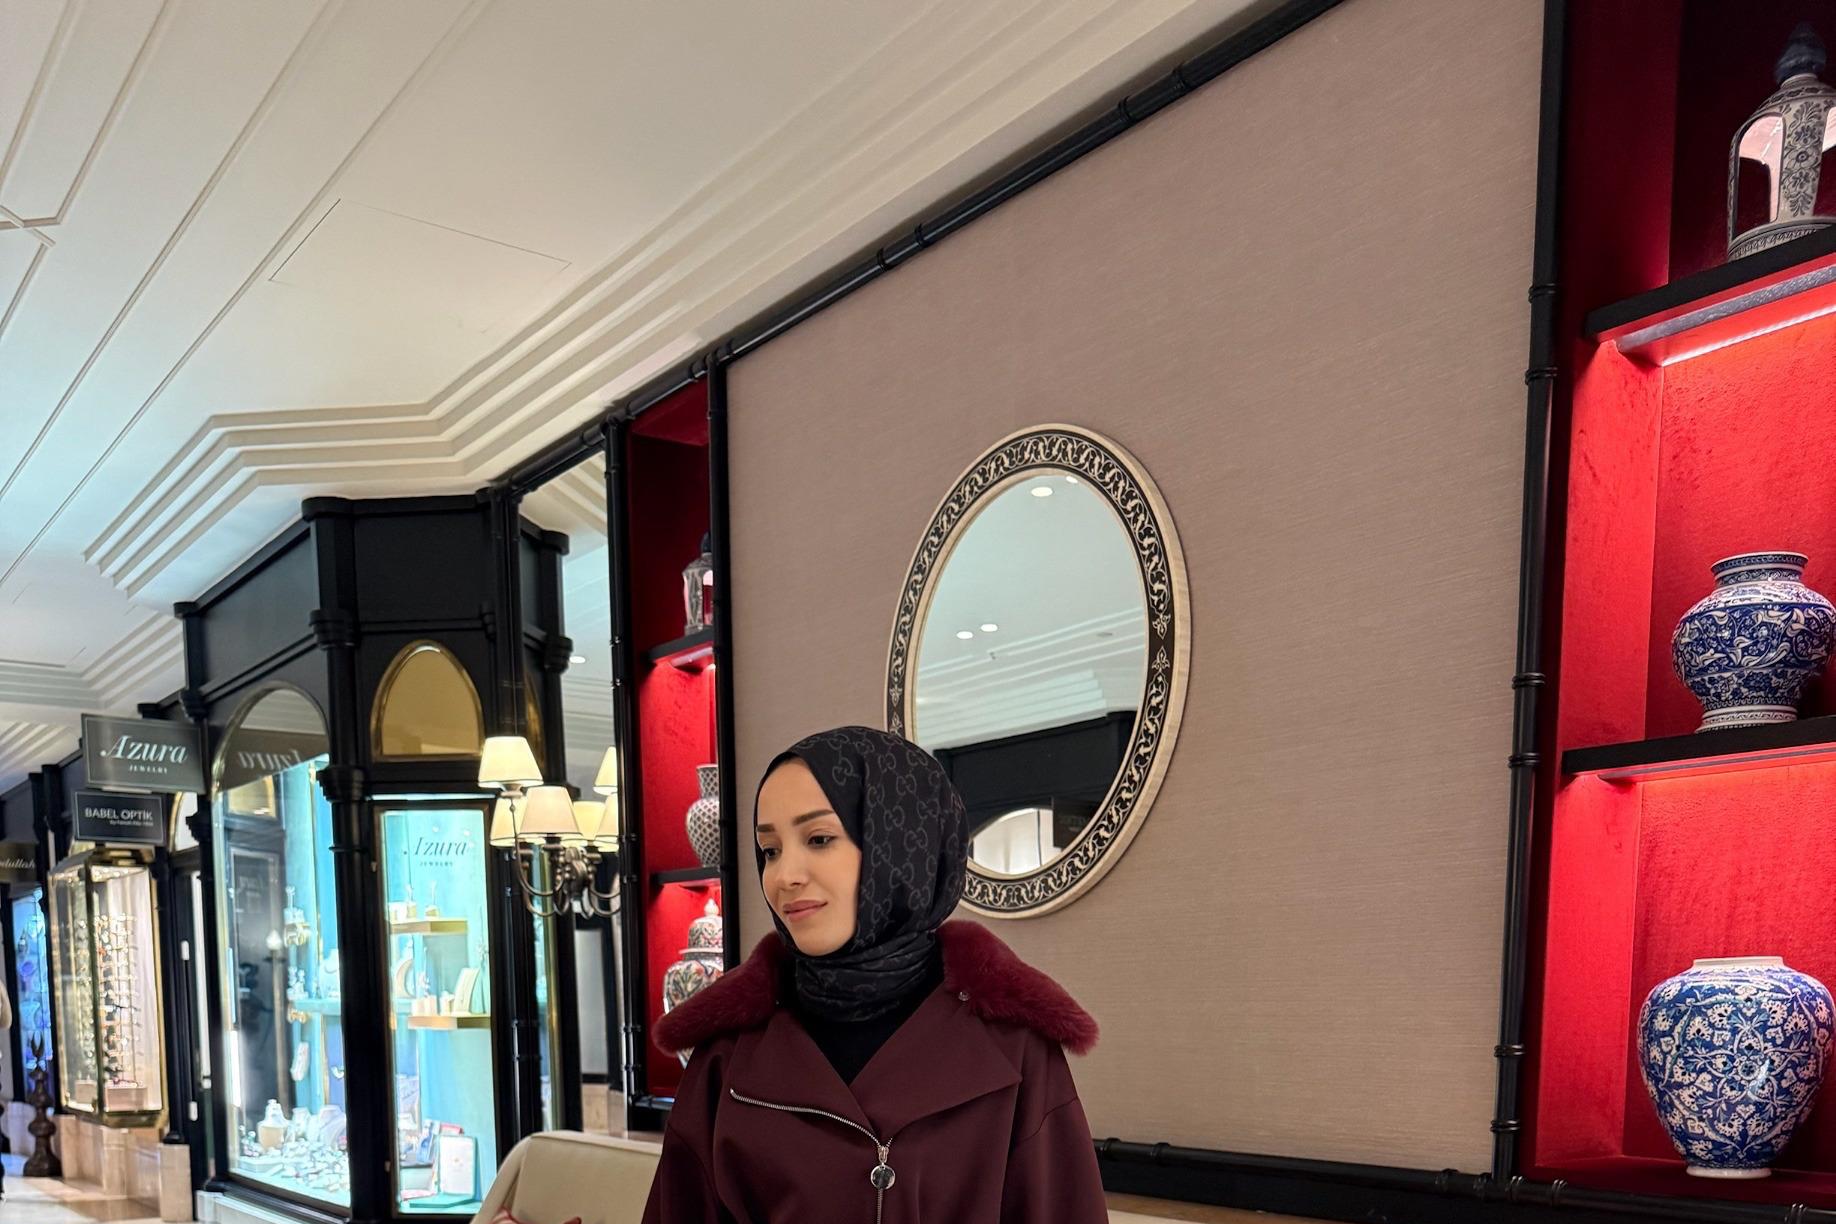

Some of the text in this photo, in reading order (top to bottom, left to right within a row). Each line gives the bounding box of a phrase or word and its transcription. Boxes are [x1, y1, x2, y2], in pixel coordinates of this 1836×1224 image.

[100, 735, 188, 763] Azura
[129, 764, 168, 774] JEWELRY
[85, 807, 119, 820] BABEL
[403, 837, 467, 856] Azura
